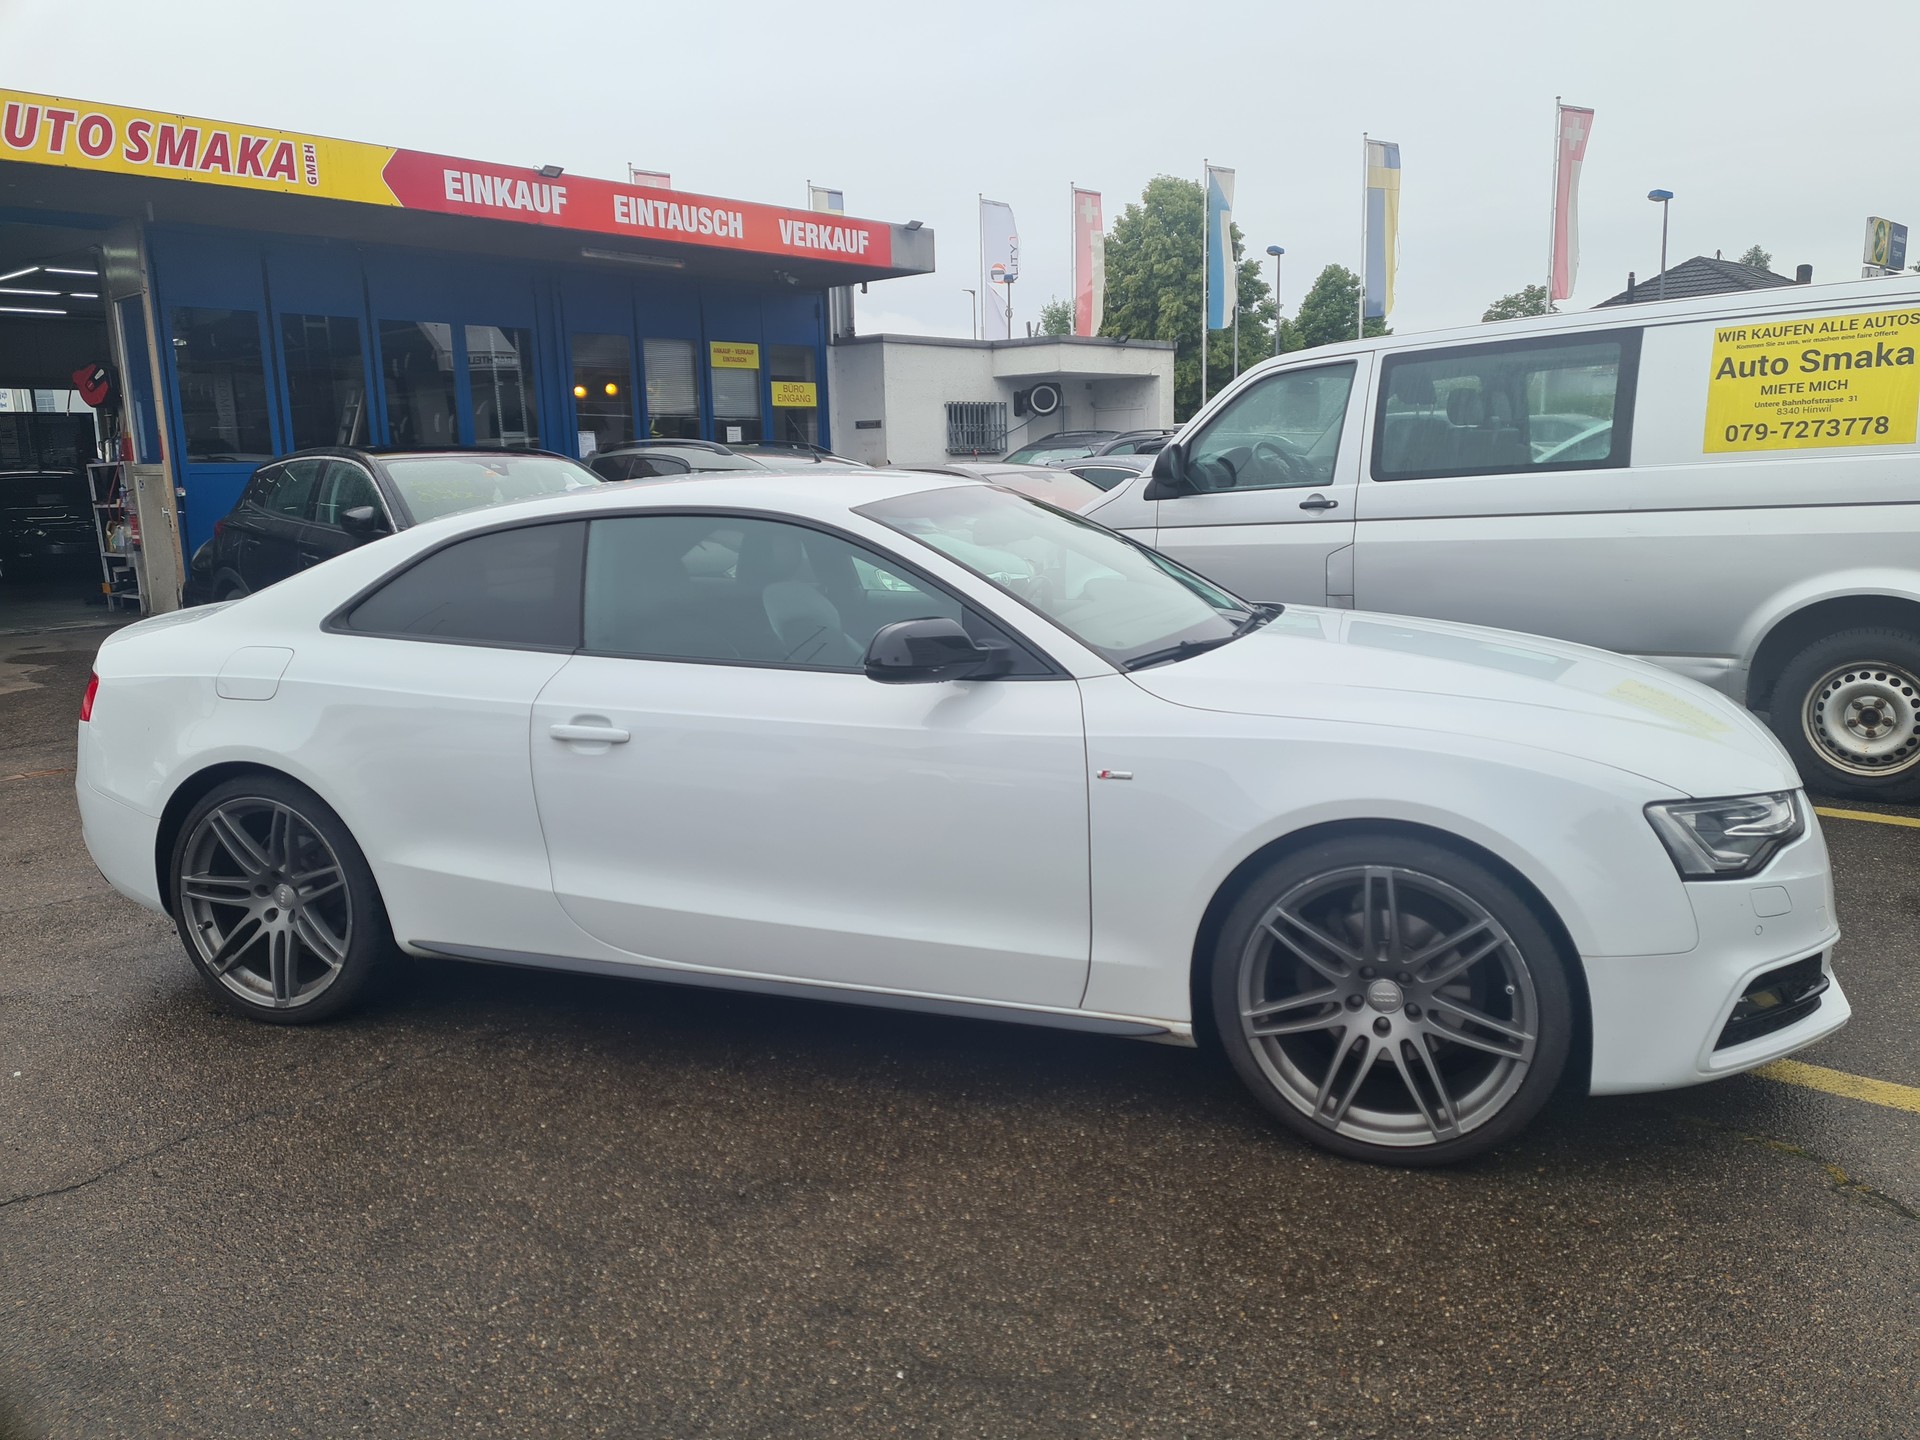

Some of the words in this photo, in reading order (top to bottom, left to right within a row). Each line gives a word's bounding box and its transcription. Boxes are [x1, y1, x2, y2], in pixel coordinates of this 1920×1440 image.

[122, 118, 299, 183] SMAKA
[302, 143, 319, 187] GMBH
[443, 169, 567, 215] EINKAUF
[613, 194, 743, 239] EINTAUSCH
[778, 218, 869, 254] VERKAUF
[1718, 330, 1747, 343] WIR
[1751, 323, 1814, 340] KAUFEN
[1819, 318, 1859, 333] ALLE
[1863, 312, 1920, 329] AUTOS
[1736, 342, 1764, 350] Kommen
[1813, 335, 1840, 343] machen
[1841, 333, 1856, 341] eine
[1715, 355, 1789, 379] Auto
[1799, 342, 1915, 373] Smaka
[783, 384, 805, 393] BÜRO
[1760, 382, 1805, 395] MIETE
[1809, 379, 1849, 392] MICH
[777, 394, 811, 403] EINGANG
[1782, 396, 1844, 407] Bahnhofstrasse
[1776, 407, 1800, 416] 8340
[1802, 405, 1832, 414] Hinwil
[1725, 416, 1890, 443] 079-7273778
